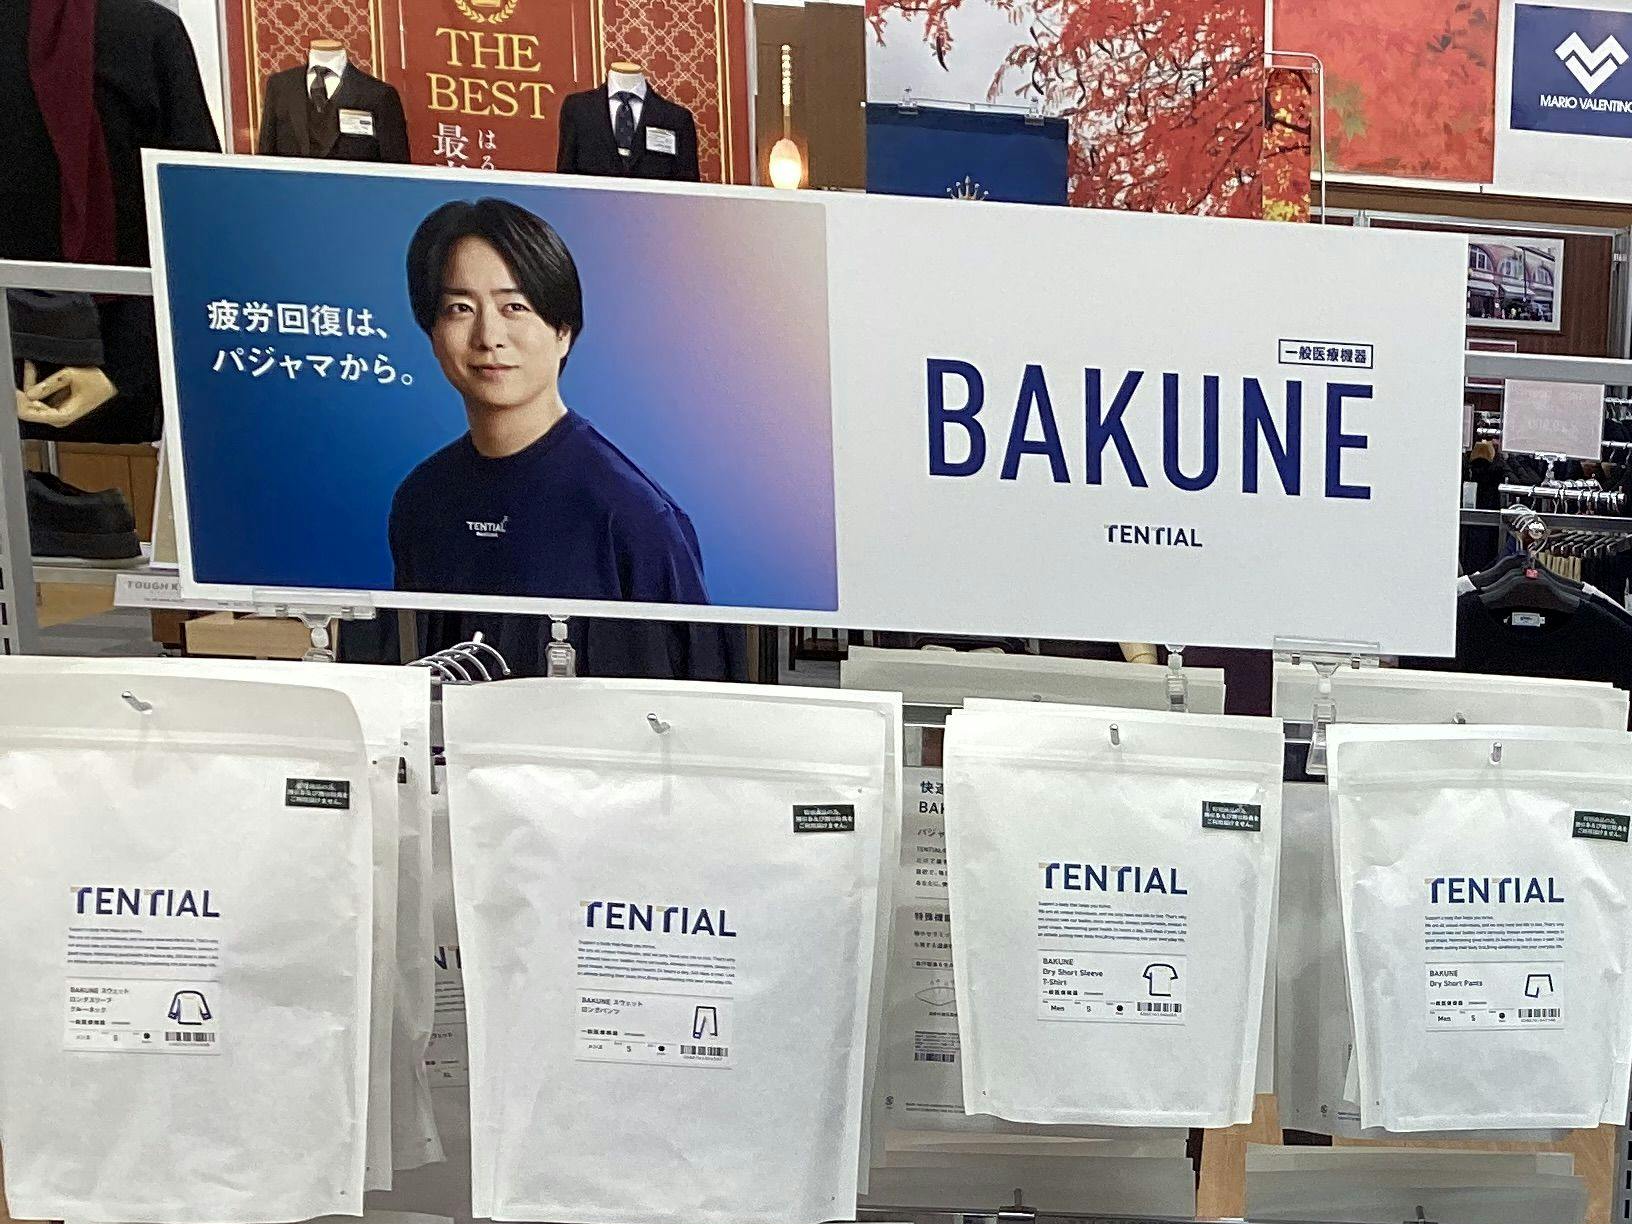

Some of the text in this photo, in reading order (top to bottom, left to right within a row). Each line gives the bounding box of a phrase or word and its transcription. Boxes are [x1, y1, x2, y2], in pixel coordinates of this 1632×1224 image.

[435, 27, 541, 72] THE
[426, 72, 555, 120] BEST
[1540, 94, 1578, 109] MARIO
[432, 122, 470, 168] 最
[207, 299, 388, 339] 疲労回復は、
[213, 347, 413, 386] パジャマから。
[1284, 346, 1367, 363] 一般医療機器
[926, 357, 1373, 500] BAKUNE
[466, 521, 506, 532] TENTIAL
[1104, 524, 1203, 548] TENTIAL
[127, 580, 168, 591] TOUGH
[1039, 863, 1188, 895] TENTIAL
[1424, 877, 1565, 903] TENTIAL
[70, 886, 220, 918] TENTIAL
[579, 900, 737, 938] TENTIAL
[1042, 969, 1056, 977] Dry
[1058, 969, 1077, 977] Short
[1429, 980, 1442, 988] Dry
